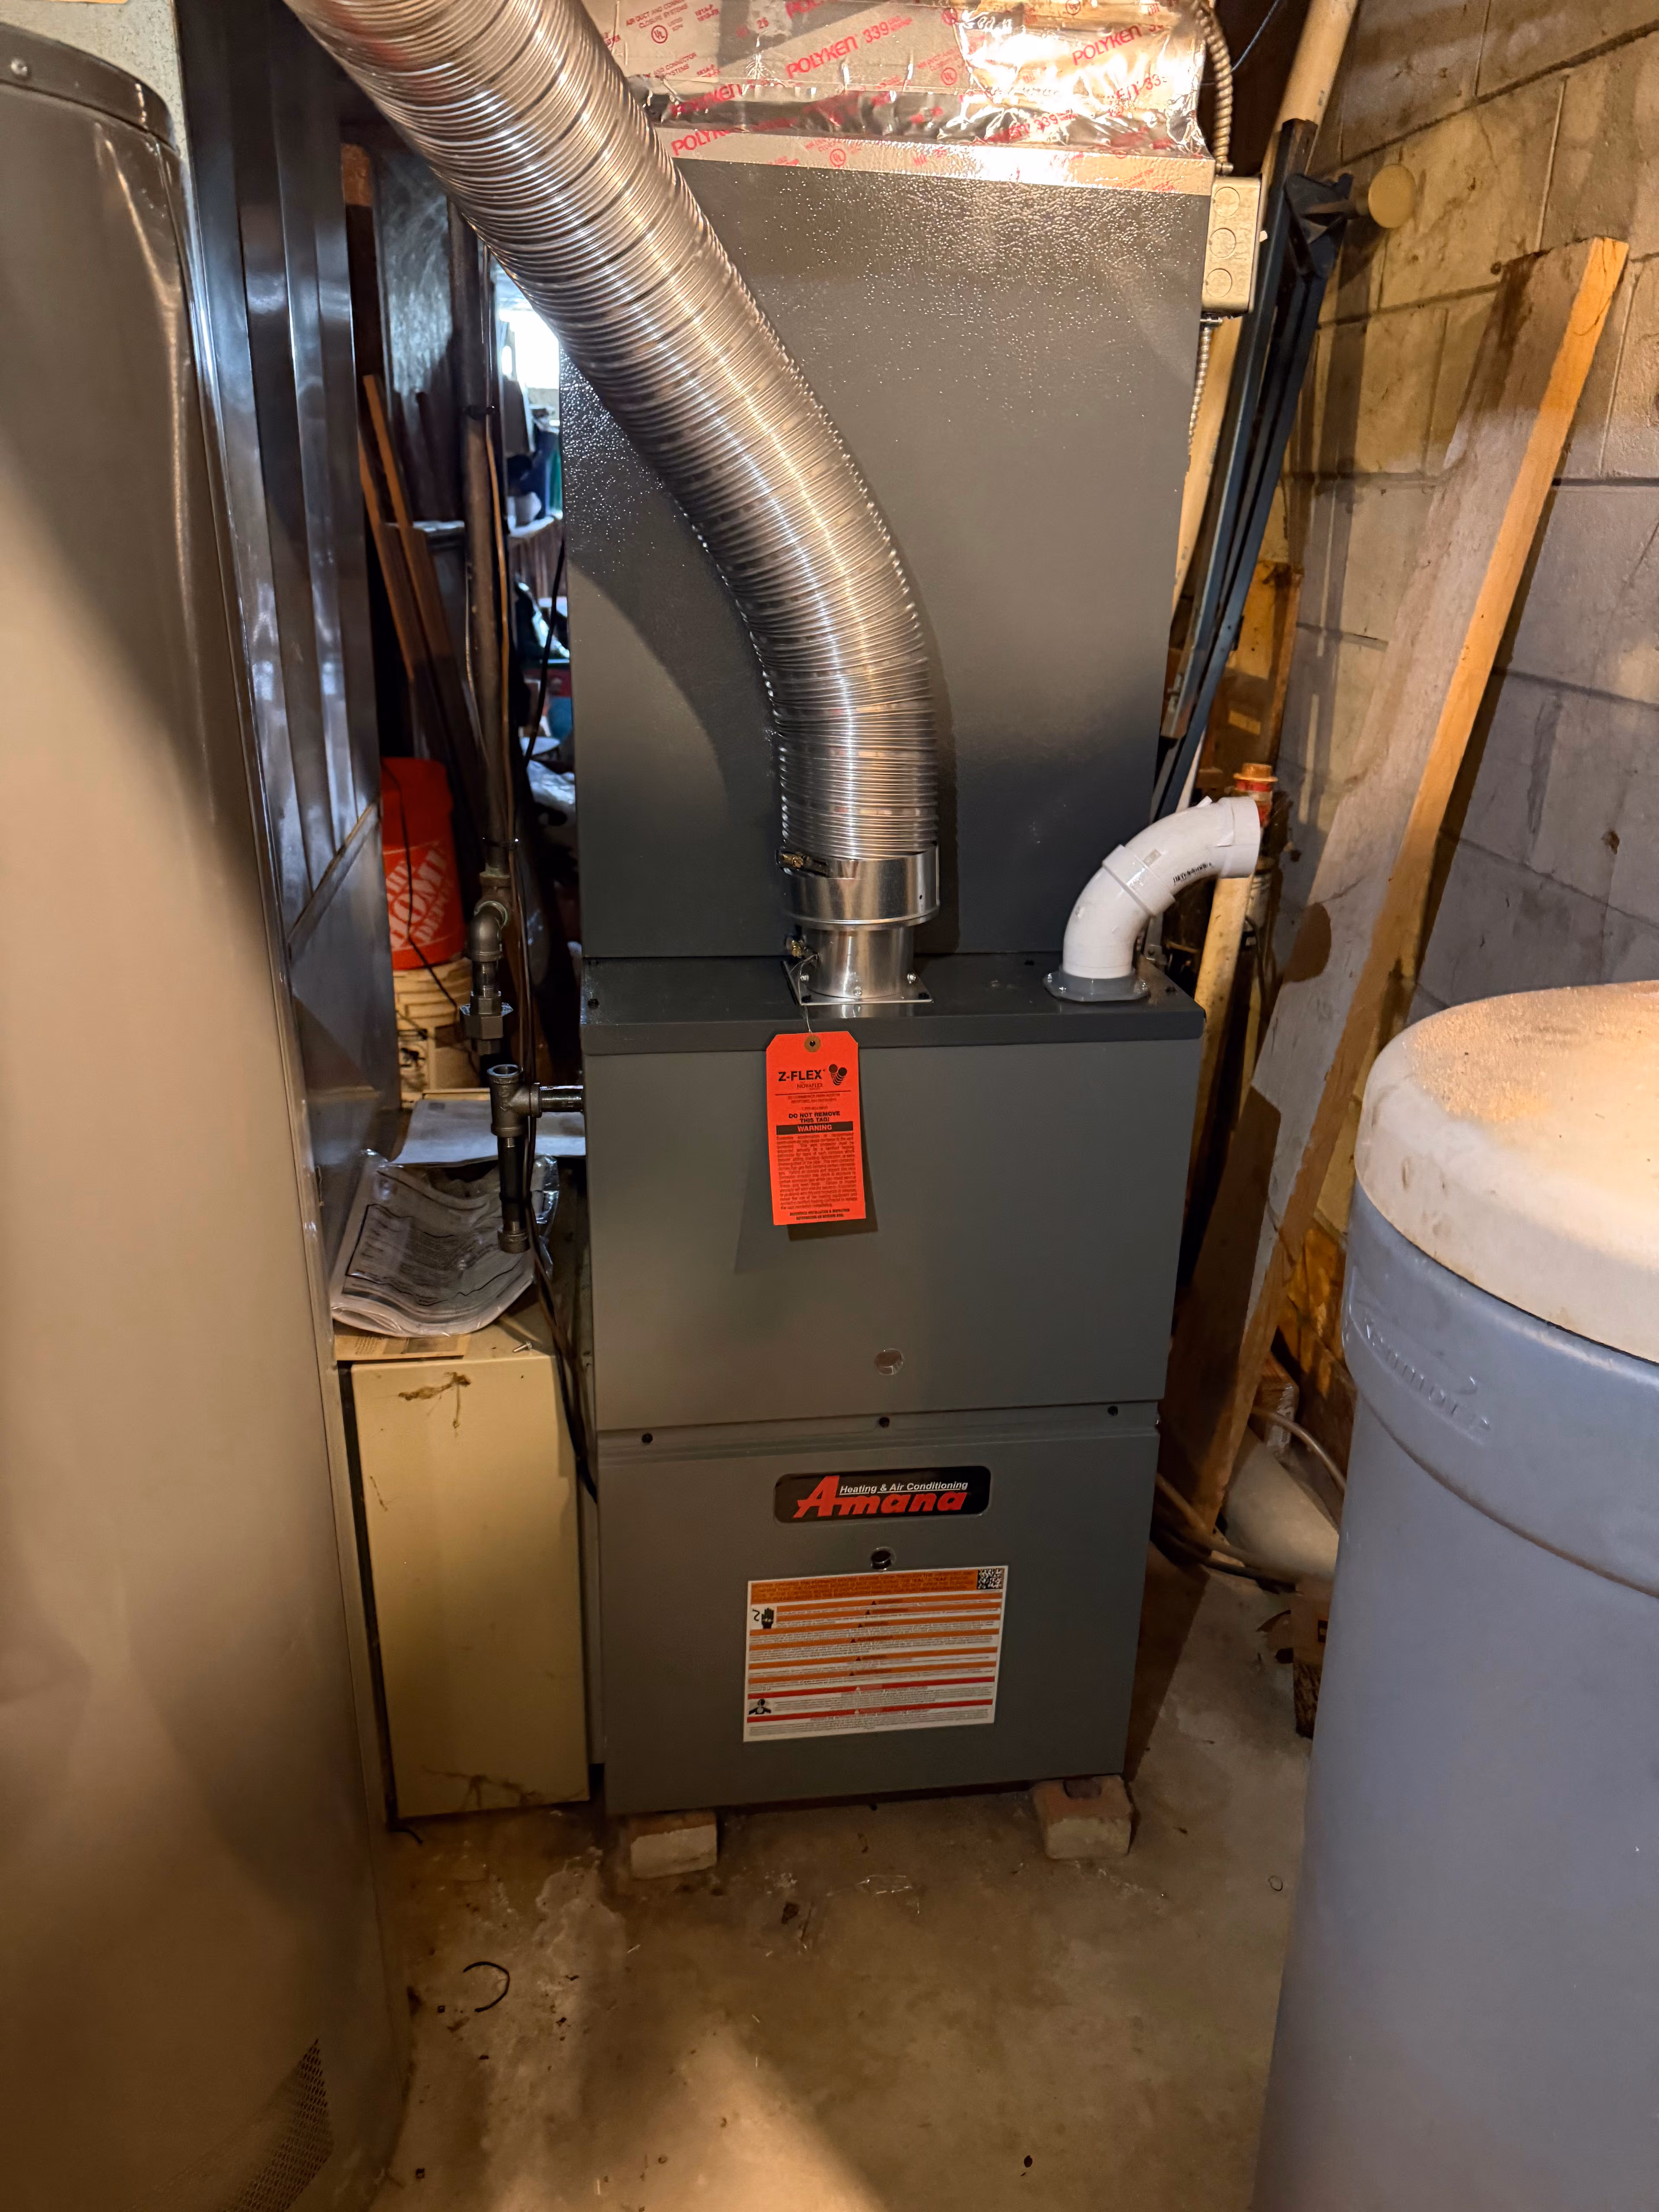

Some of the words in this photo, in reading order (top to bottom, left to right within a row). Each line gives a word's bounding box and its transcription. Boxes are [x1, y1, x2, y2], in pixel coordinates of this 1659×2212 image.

[785, 36, 858, 79] POLYKEN
[862, 22, 889, 43] 339
[1072, 25, 1142, 66] POLYKEN
[1144, 74, 1161, 90] 33
[671, 130, 731, 156] POLY
[778, 1070, 823, 1081] Z-FLEX
[793, 1475, 968, 1518] Amana
[840, 1484, 877, 1494] Heating
[890, 1483, 904, 1491] Air
[907, 1481, 969, 1491] Conditioning
